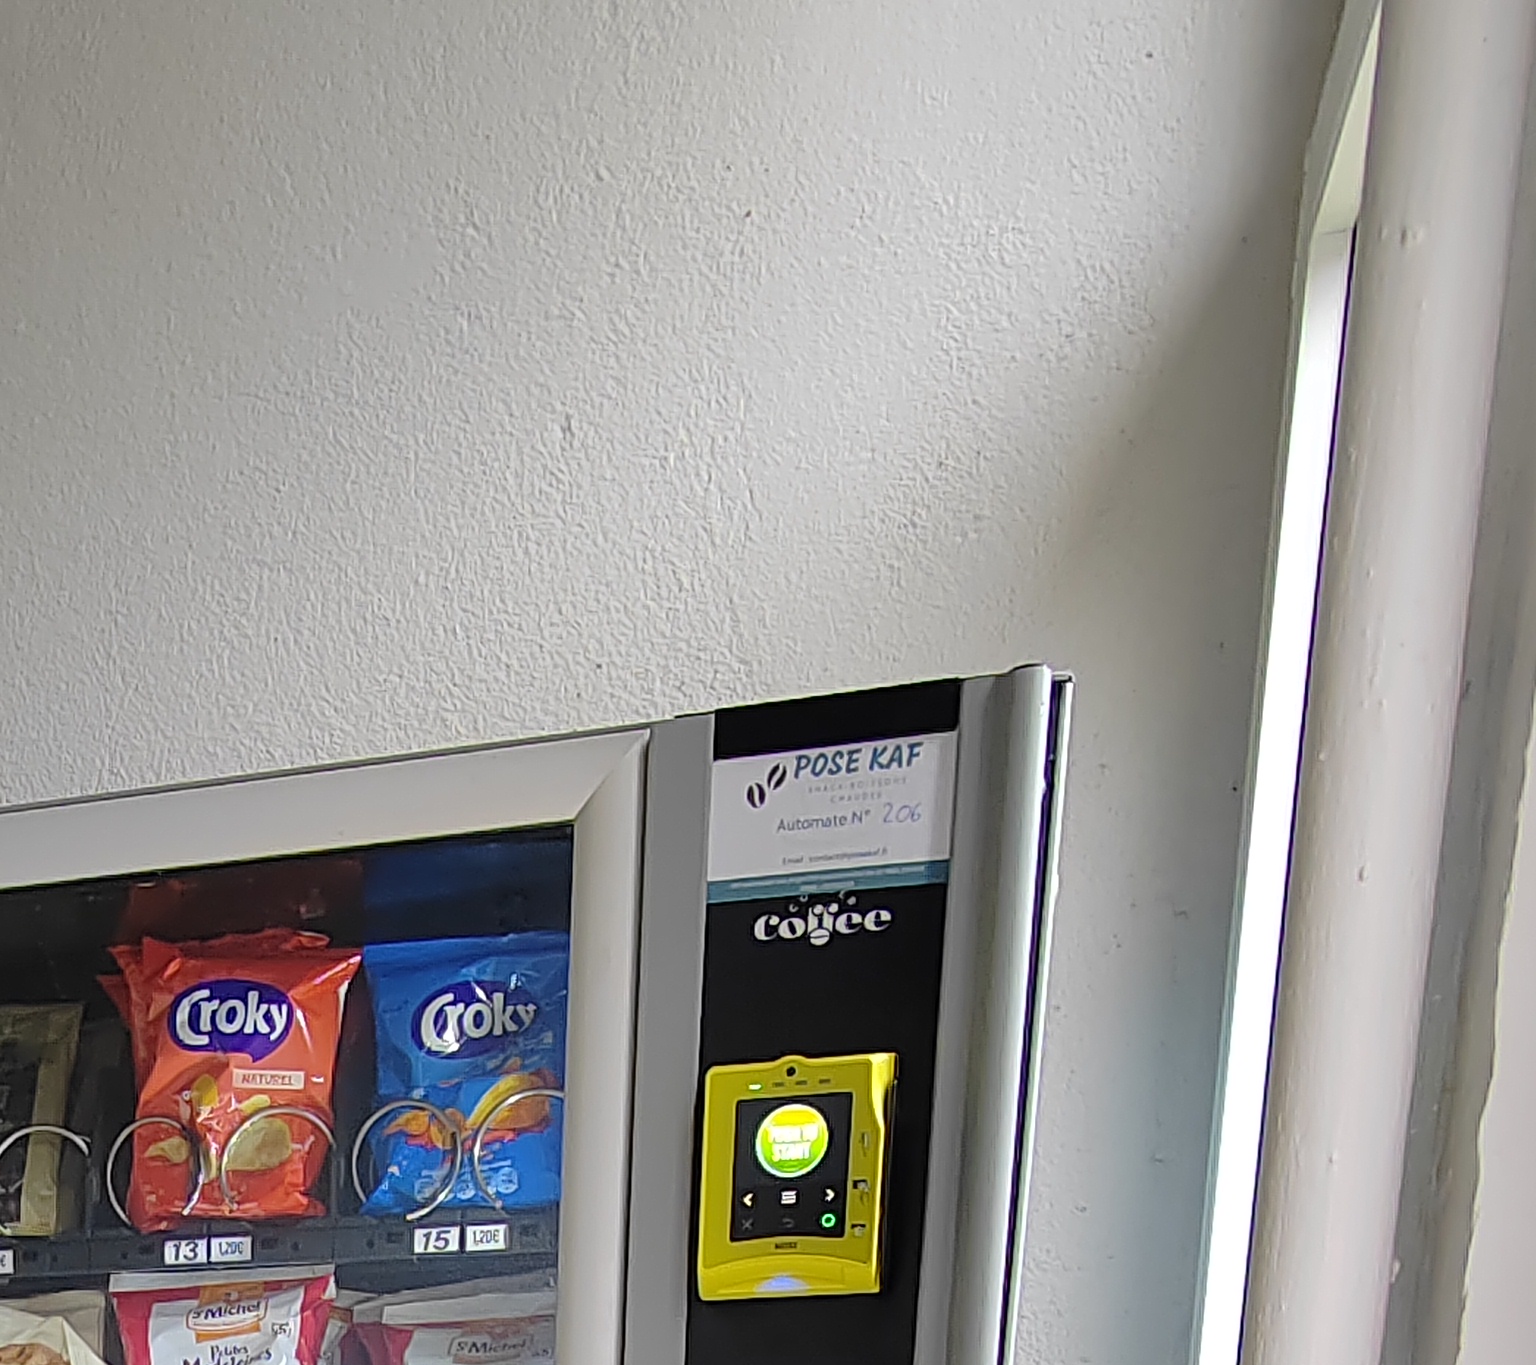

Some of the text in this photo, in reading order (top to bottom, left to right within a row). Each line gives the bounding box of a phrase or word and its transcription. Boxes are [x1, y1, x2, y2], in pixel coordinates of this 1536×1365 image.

[794, 742, 924, 779] POSE KAF
[777, 815, 847, 833] Automate
[883, 803, 922, 823] 206
[175, 989, 289, 1046] Croky
[420, 992, 538, 1054] Croky
[242, 1074, 295, 1086] NATUREL
[173, 1241, 200, 1262] 13
[422, 1229, 452, 1251] 15
